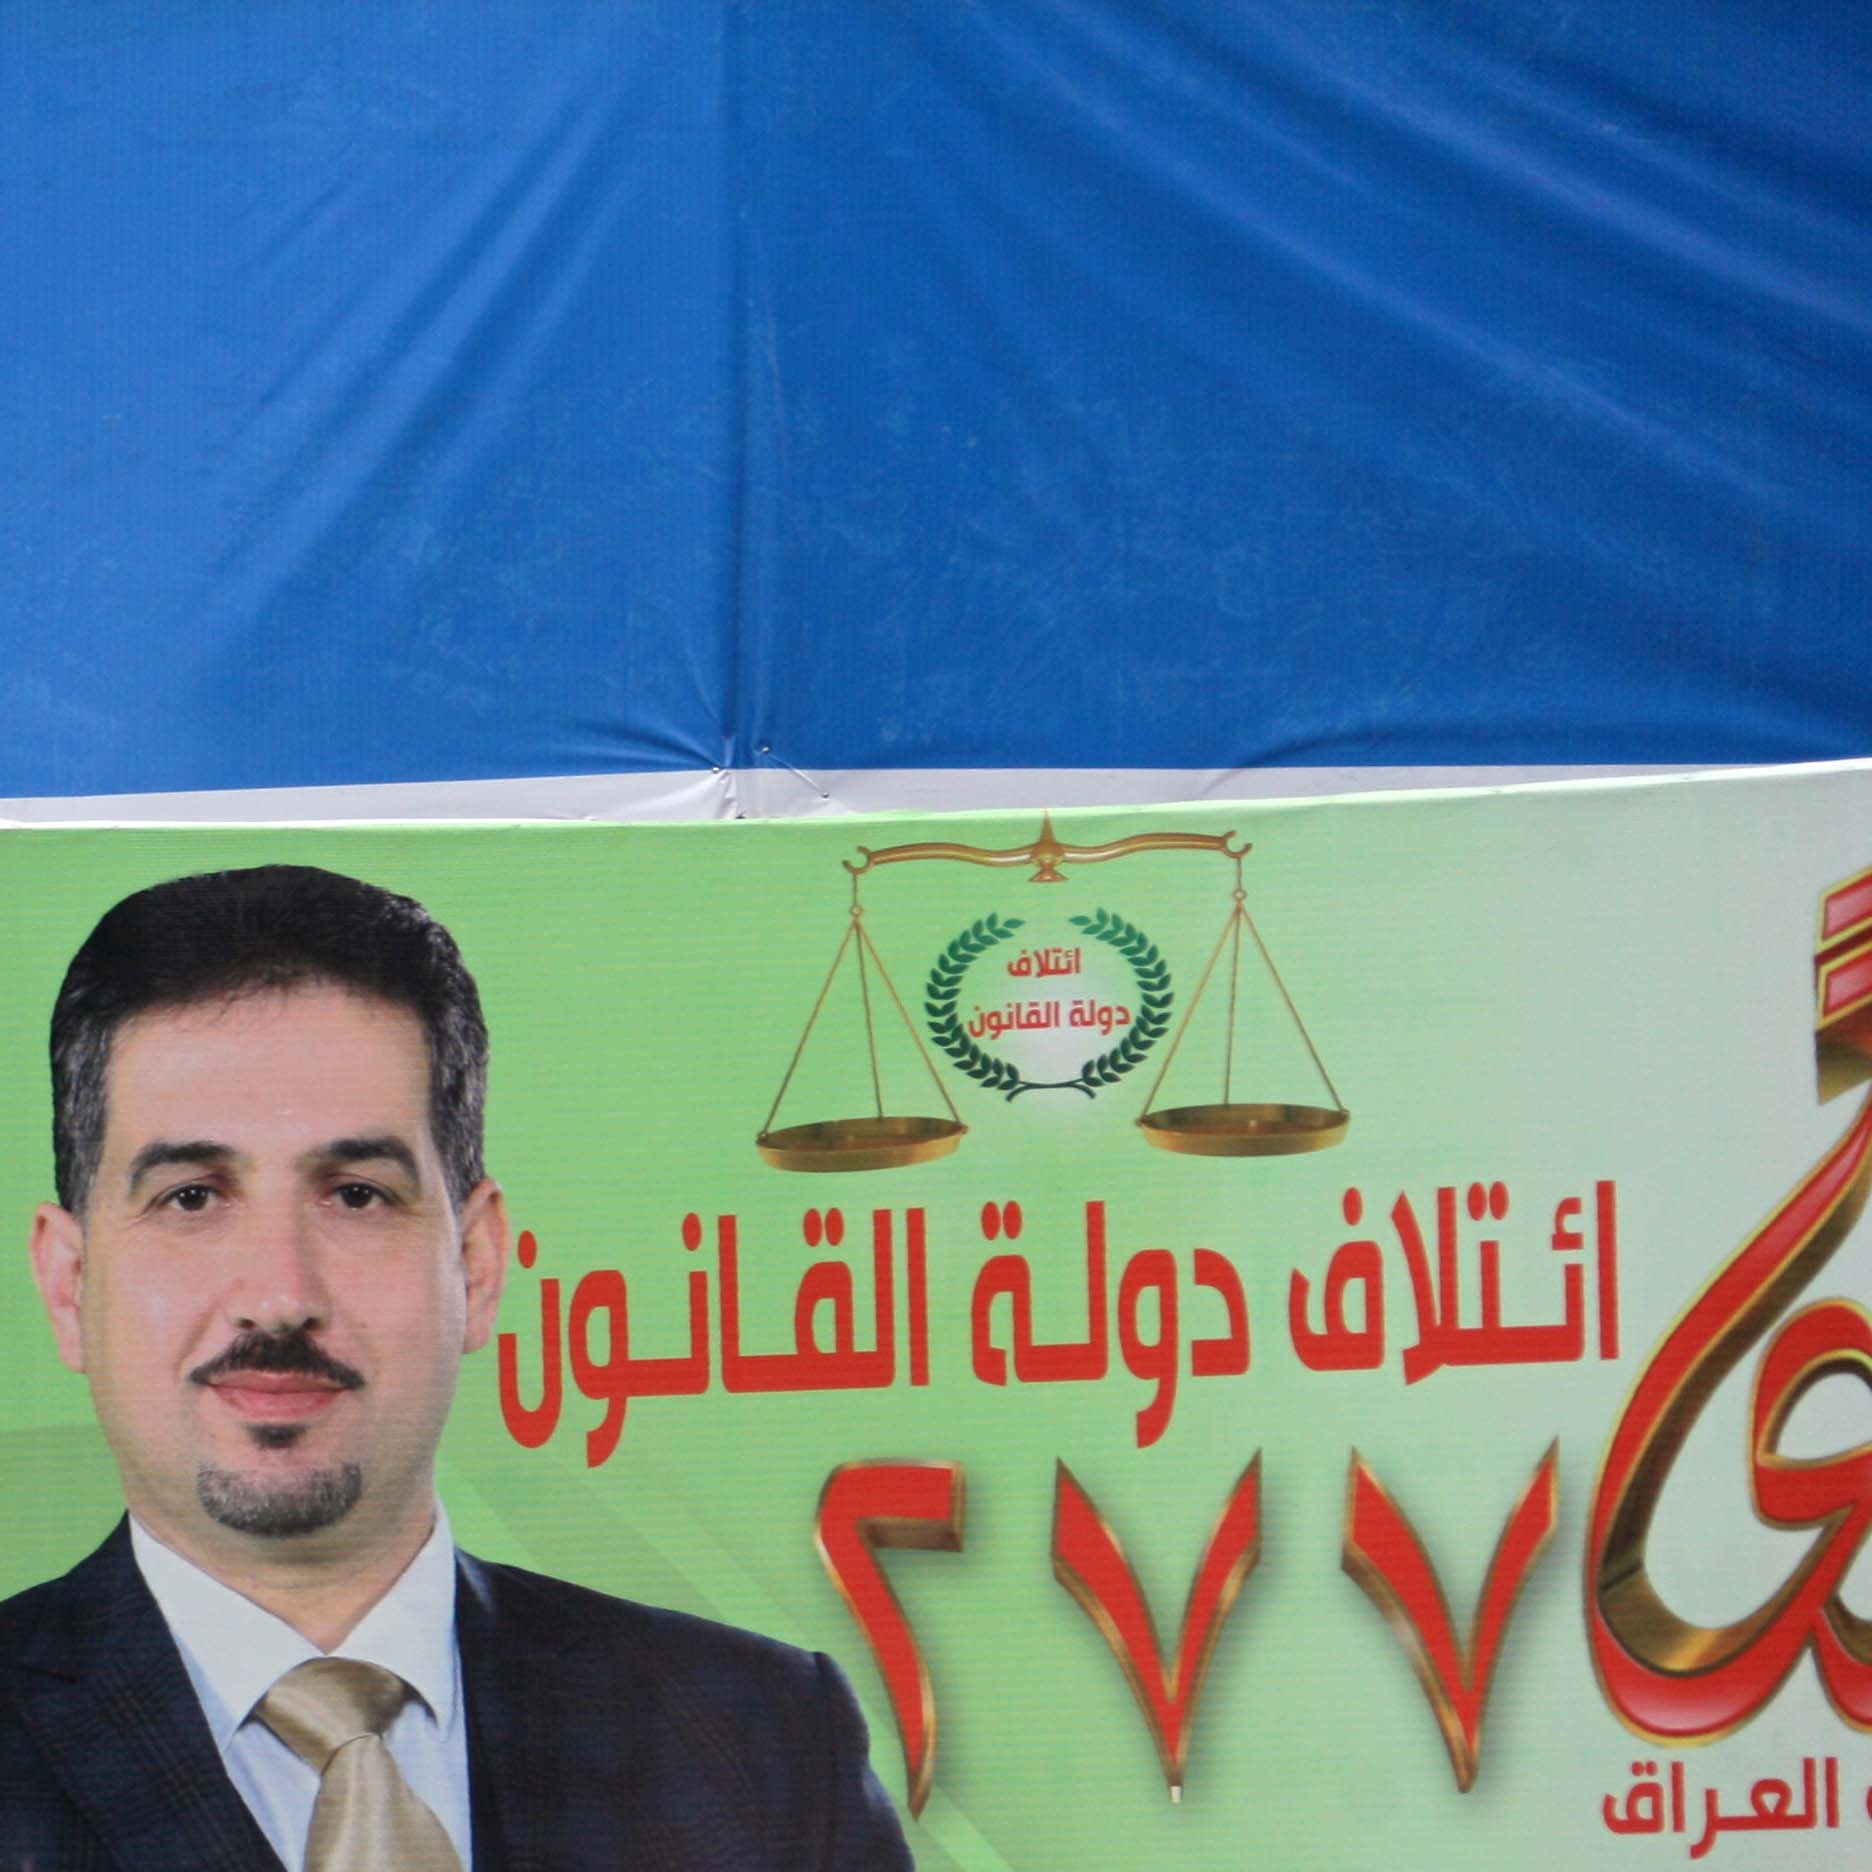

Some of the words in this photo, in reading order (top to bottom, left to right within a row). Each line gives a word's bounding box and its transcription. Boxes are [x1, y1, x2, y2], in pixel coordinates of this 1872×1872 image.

[968, 1001, 1060, 1041] القانون
[1068, 1000, 1131, 1036] دولة
[494, 1205, 929, 1469] القانون
[968, 1200, 1250, 1449] دولة
[1286, 1179, 1620, 1387] ائتلاف
[814, 1434, 1560, 1823] ٢٧٧
[1602, 1756, 1840, 1860] العراق
